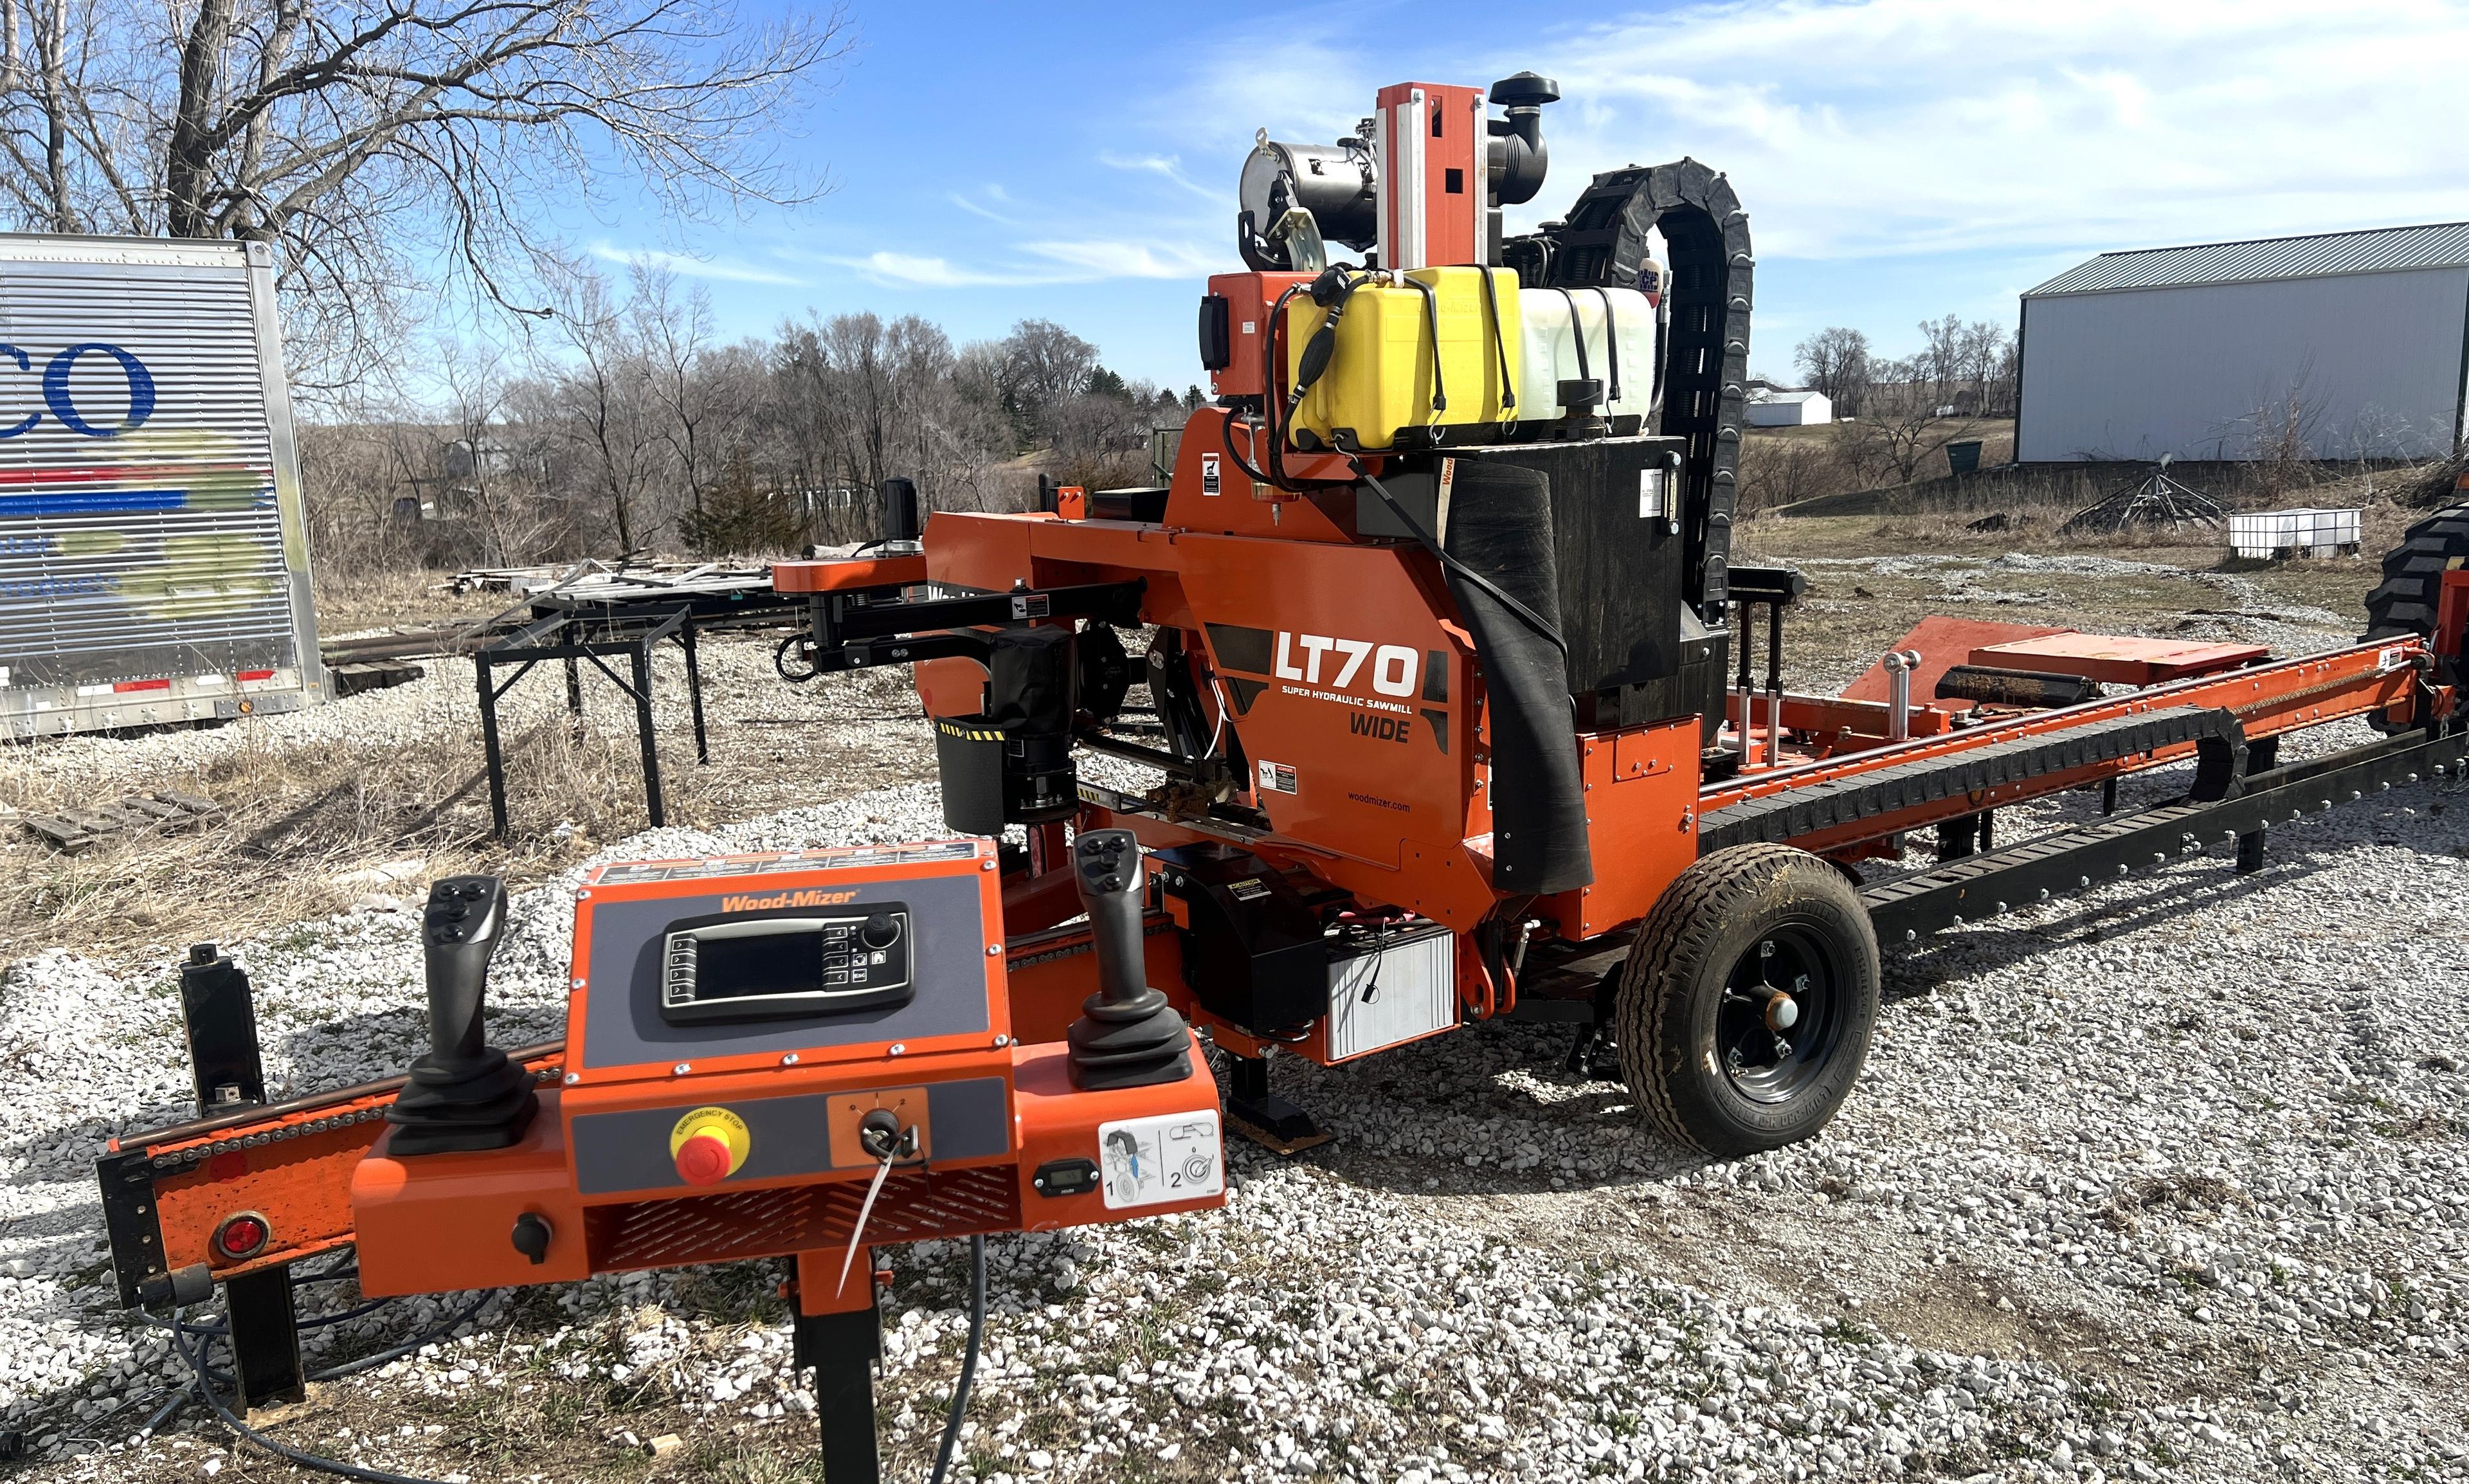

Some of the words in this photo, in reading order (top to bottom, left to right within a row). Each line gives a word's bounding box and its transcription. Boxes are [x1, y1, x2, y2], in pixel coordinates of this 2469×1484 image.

[1276, 631, 1418, 698] LT70
[1282, 685, 1310, 697] SUPER
[1312, 691, 1364, 707] HYDRAULIC
[1366, 700, 1412, 714] SAWMILL
[1350, 712, 1411, 743] WIDE
[1348, 792, 1410, 813] woodmizer.com
[722, 890, 856, 913] Wood-Mizer
[676, 1110, 723, 1135] EMERGENCY
[724, 1114, 743, 1130] STOP
[1106, 1180, 1114, 1196] 1
[1170, 1172, 1182, 1188] 2
